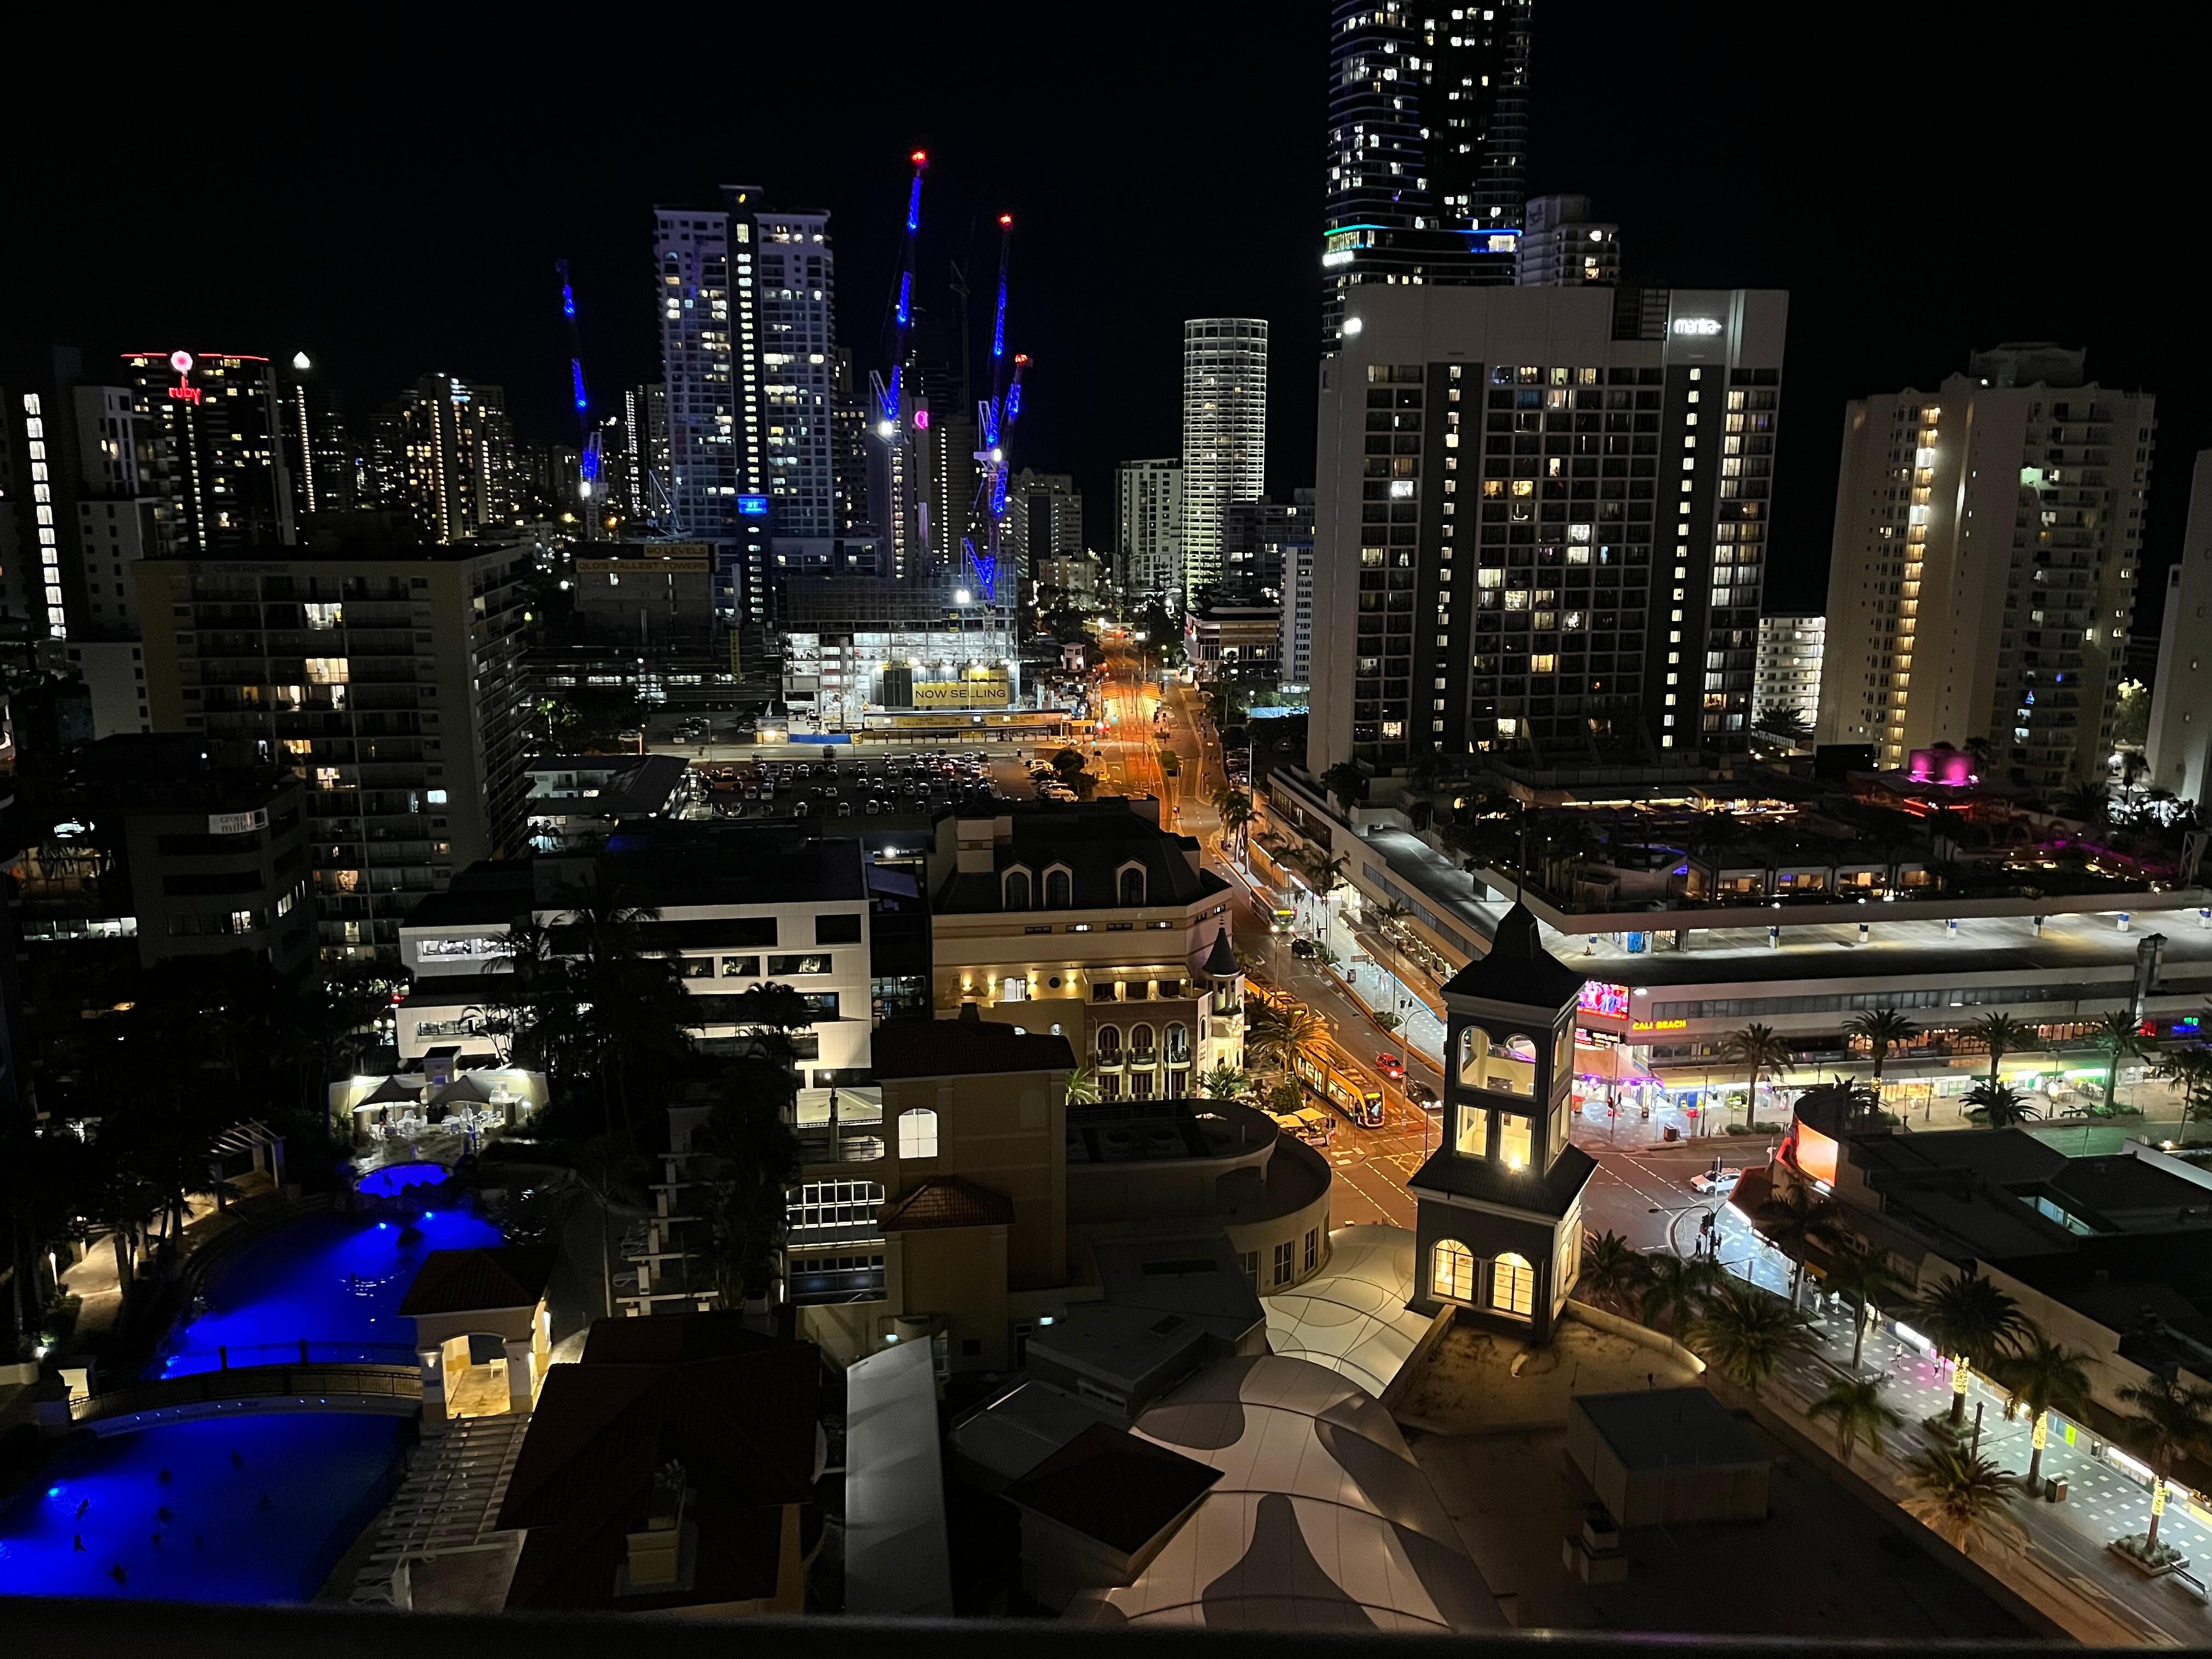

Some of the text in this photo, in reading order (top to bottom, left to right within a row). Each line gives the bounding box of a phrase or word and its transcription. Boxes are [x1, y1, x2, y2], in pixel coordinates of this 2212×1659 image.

[169, 376, 201, 405] ruby
[915, 689, 1006, 698] NOW SELLING
[1632, 1020, 1686, 1030] CALI BEACH
